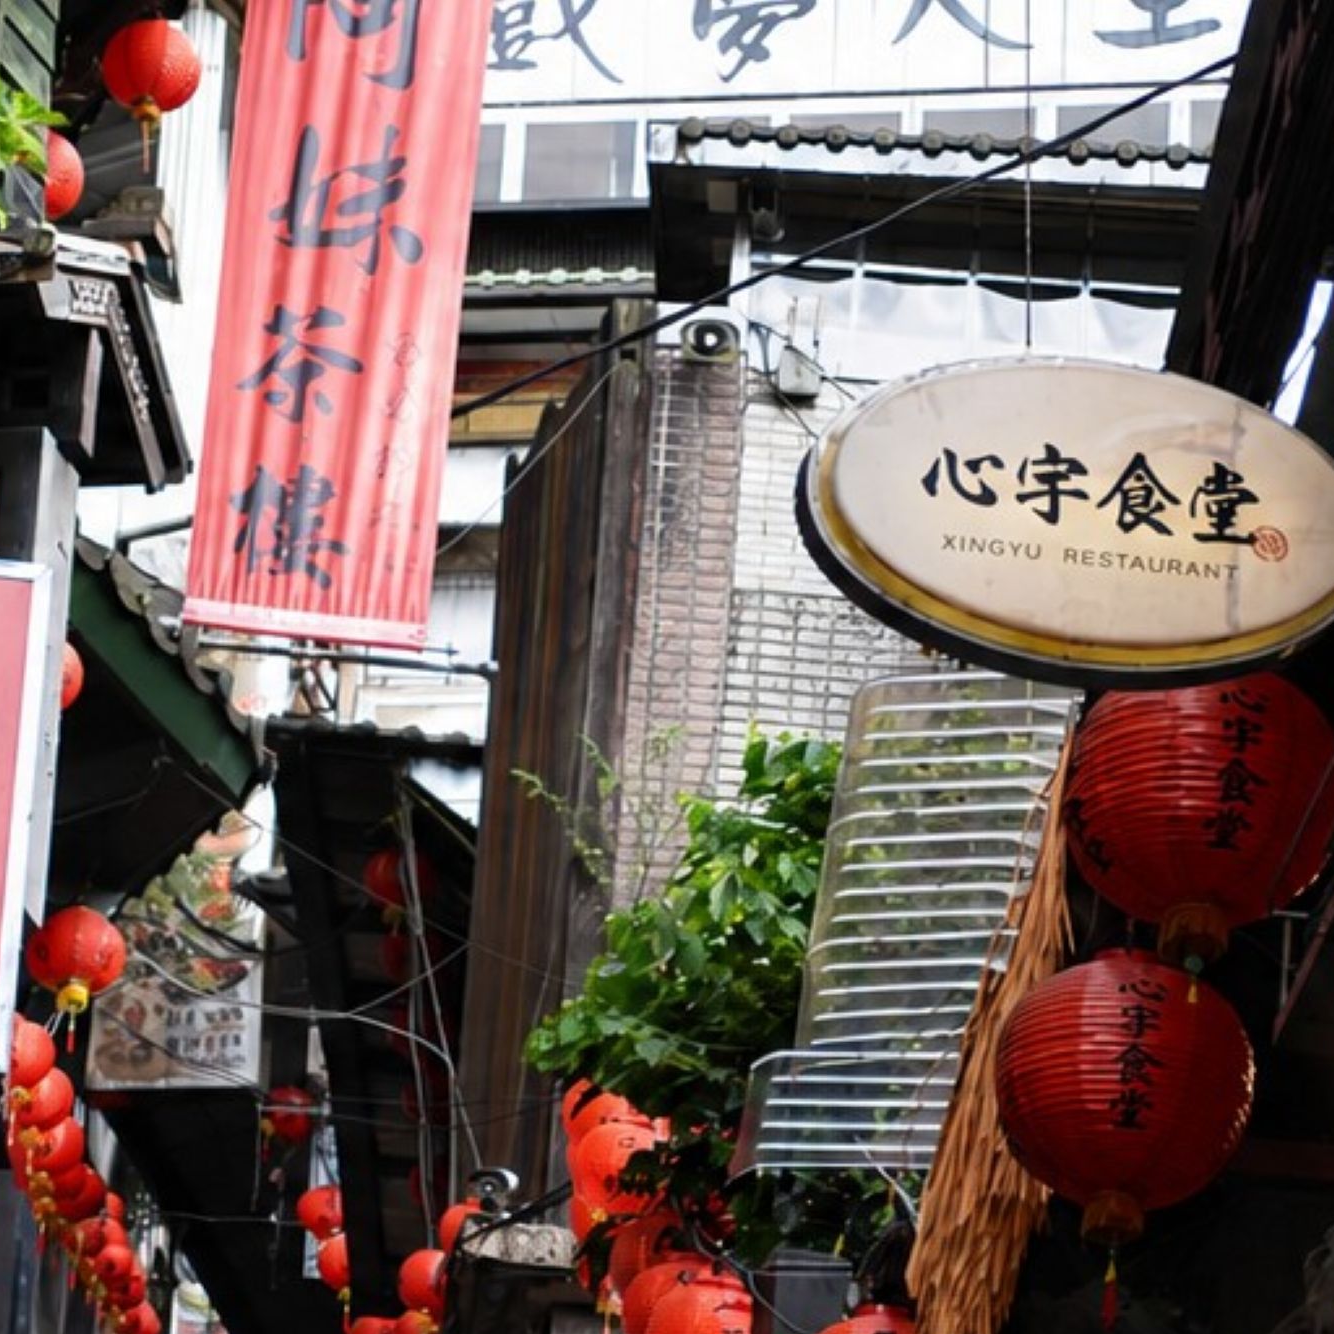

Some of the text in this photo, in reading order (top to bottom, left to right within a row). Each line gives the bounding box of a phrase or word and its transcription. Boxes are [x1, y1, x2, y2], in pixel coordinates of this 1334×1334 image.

[921, 443, 1261, 544] 心宇食堂
[941, 534, 1239, 580] XINGYU RESTAURANT
[1201, 687, 1271, 850] 心宇食堂
[1108, 978, 1167, 1130] 心宇食堂
